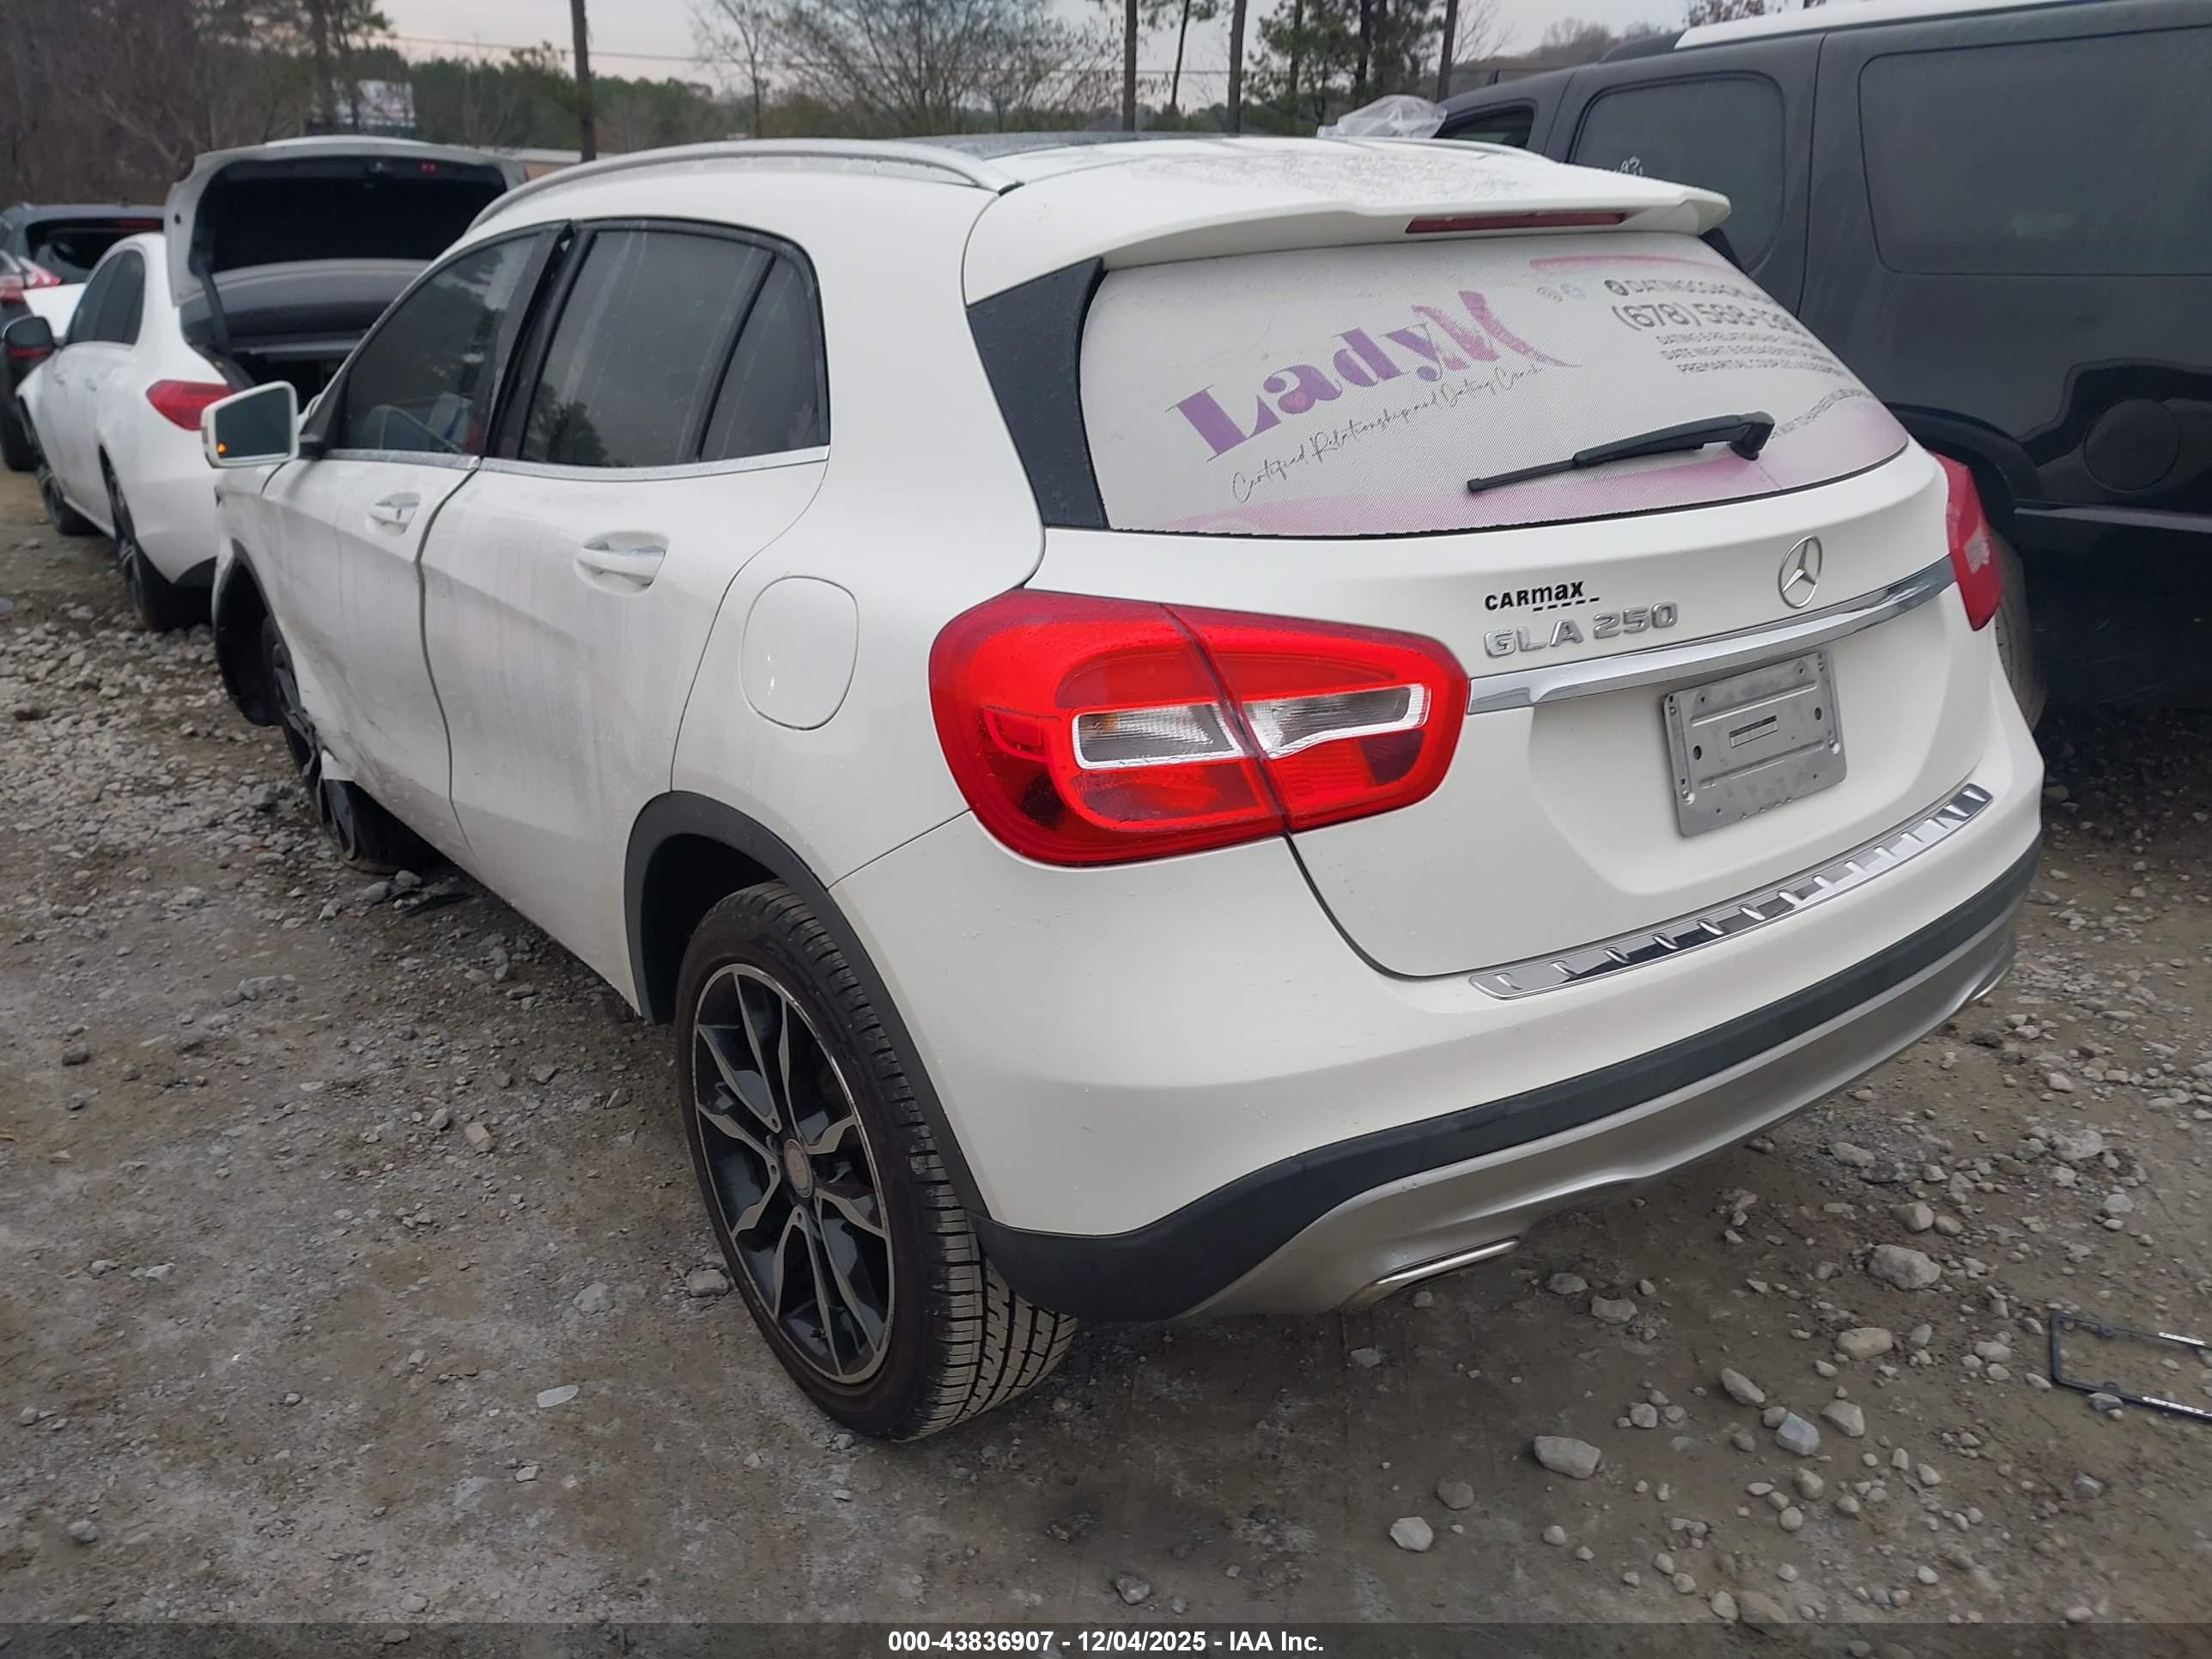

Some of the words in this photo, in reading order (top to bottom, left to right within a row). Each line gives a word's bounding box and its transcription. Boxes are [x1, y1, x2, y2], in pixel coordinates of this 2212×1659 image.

[1611, 302, 1702, 331] (678)
[1484, 617, 1583, 658] GLA
[1593, 602, 1679, 641] 250
